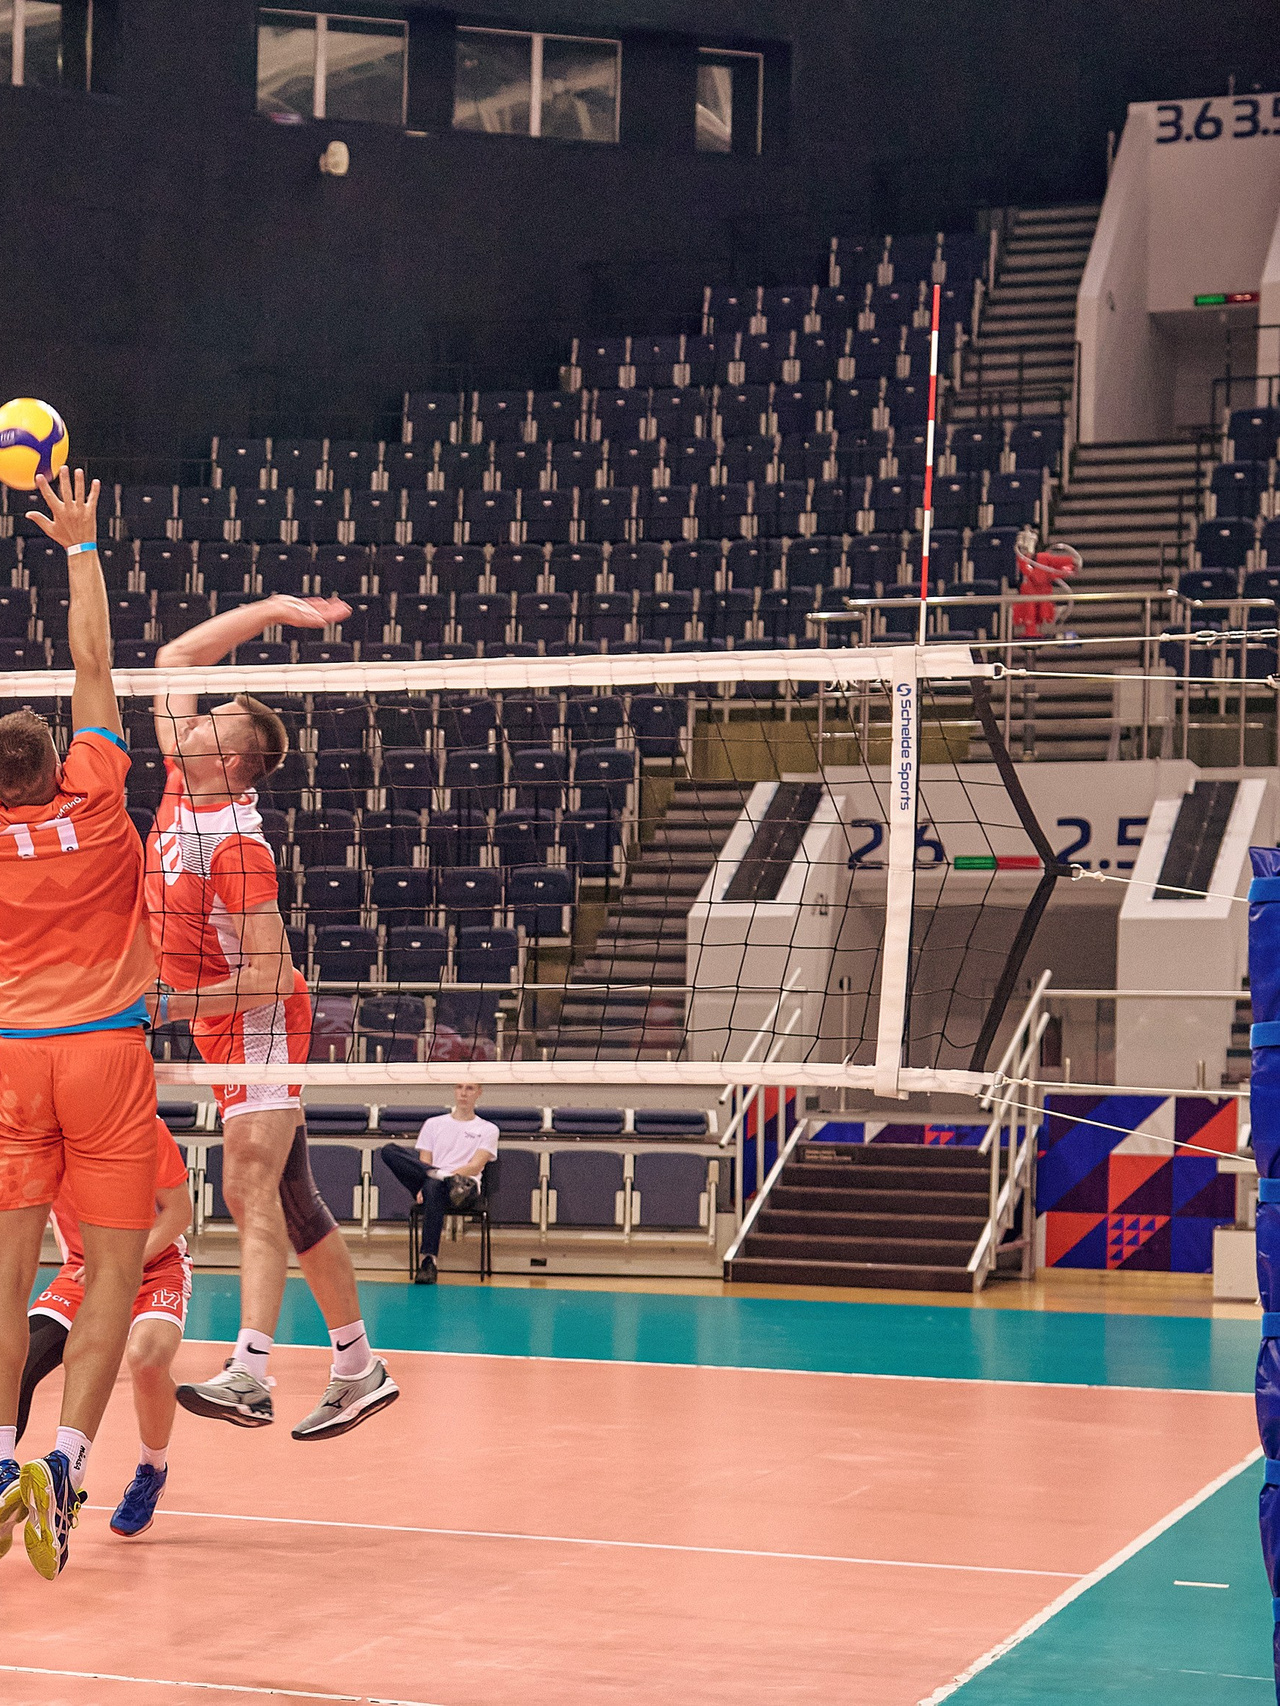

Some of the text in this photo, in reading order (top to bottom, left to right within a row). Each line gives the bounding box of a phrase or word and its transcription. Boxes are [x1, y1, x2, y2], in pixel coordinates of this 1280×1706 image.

[1156, 101, 1223, 144] 3.6
[898, 699, 912, 811] Schelde Sports
